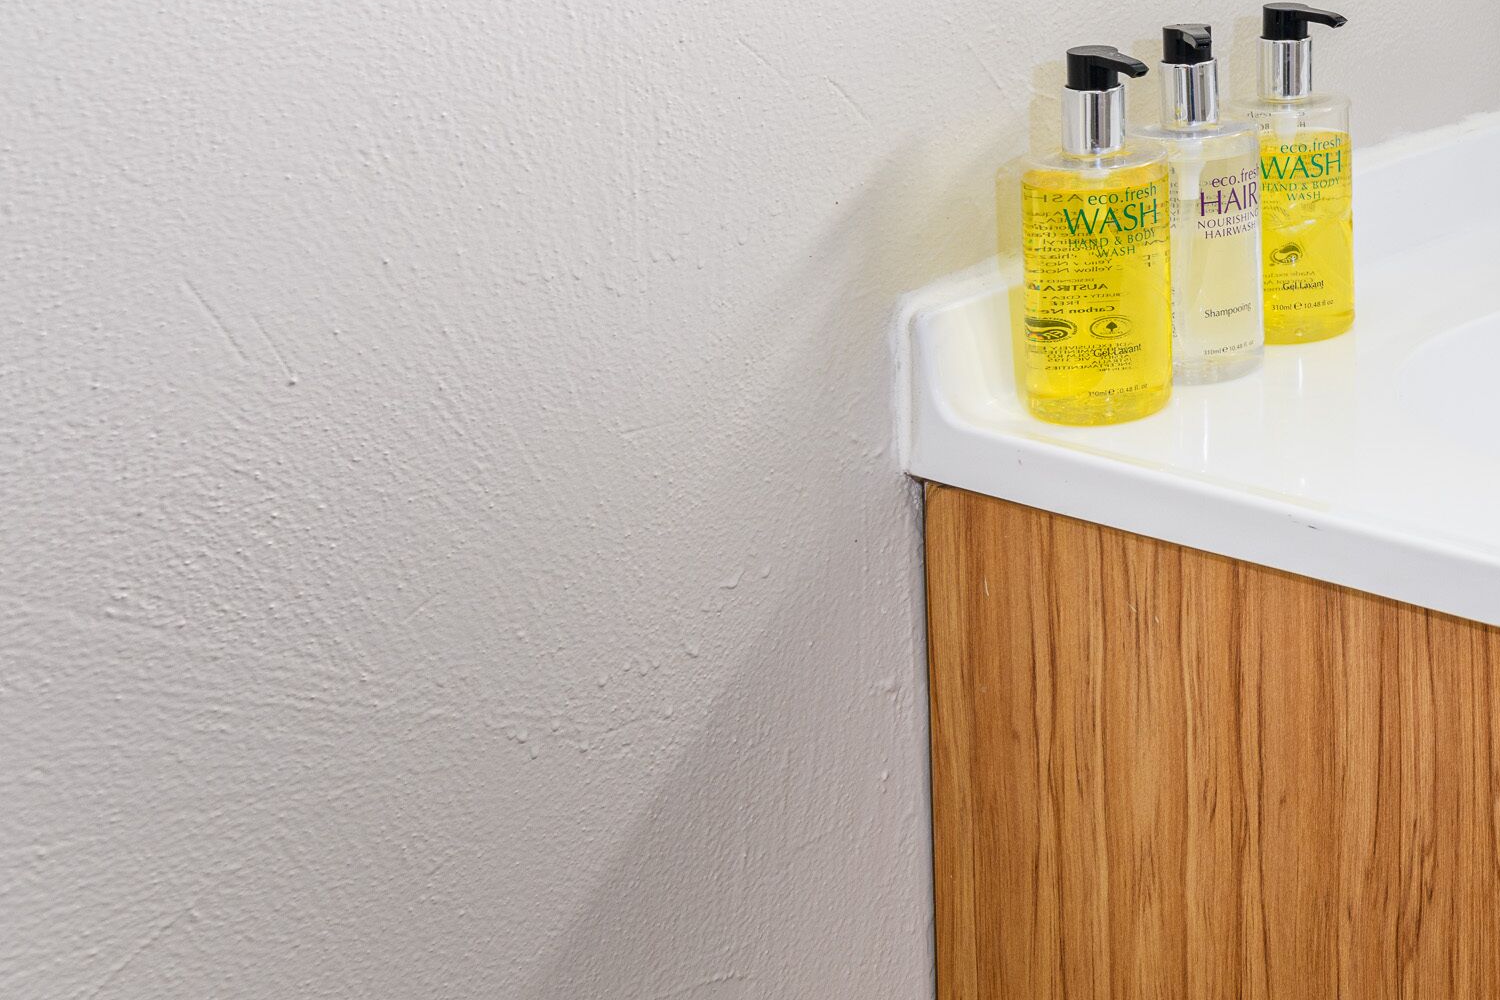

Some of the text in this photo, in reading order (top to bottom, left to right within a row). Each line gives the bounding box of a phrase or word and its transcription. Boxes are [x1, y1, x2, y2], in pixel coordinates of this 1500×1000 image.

[1280, 135, 1342, 153] eco.fresh
[1260, 149, 1341, 180] WASH
[1262, 176, 1340, 192] HAND & BODY
[1087, 182, 1157, 206] eco.fresh
[1200, 181, 1258, 217] HAIR
[1286, 190, 1321, 201] WASH
[1062, 198, 1157, 236] WASH
[1197, 207, 1259, 230] NOURISHING
[1067, 228, 1156, 250] HAND & BODY
[1204, 222, 1256, 239] HAIRWASH
[1095, 245, 1136, 258] WASH
[1282, 282, 1298, 290] Gel
[1299, 280, 1325, 290] Lavant
[1204, 302, 1252, 318] Shampooing
[1272, 303, 1292, 311] 310ml
[1304, 301, 1320, 309] 10.48
[1093, 343, 1142, 358] Gel Lavant
